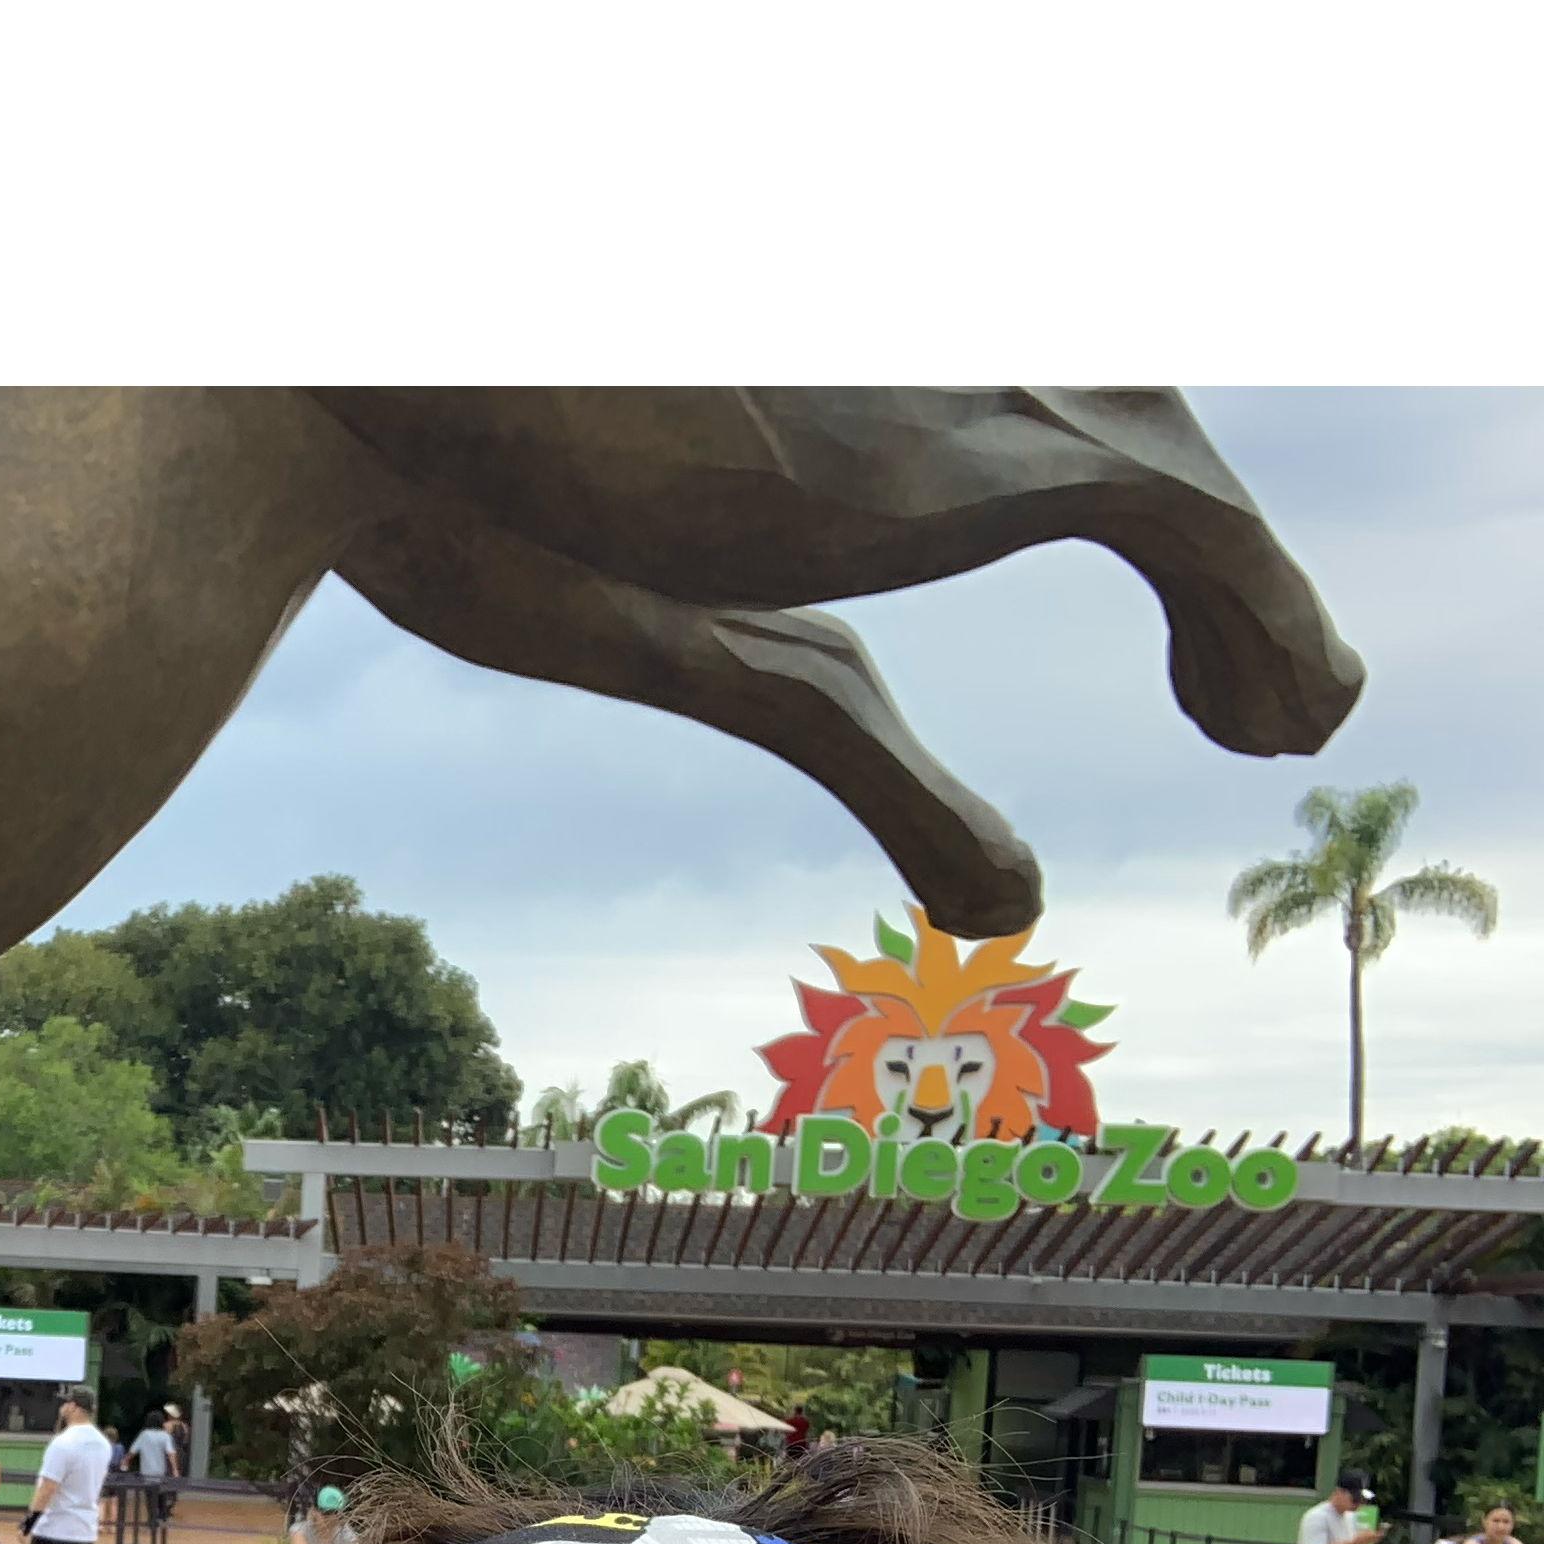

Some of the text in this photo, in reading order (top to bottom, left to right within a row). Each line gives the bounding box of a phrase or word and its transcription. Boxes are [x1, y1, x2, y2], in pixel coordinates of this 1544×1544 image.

[591, 1107, 1300, 1222] San Diego Zoo
[1204, 1362, 1273, 1383] Tickets
